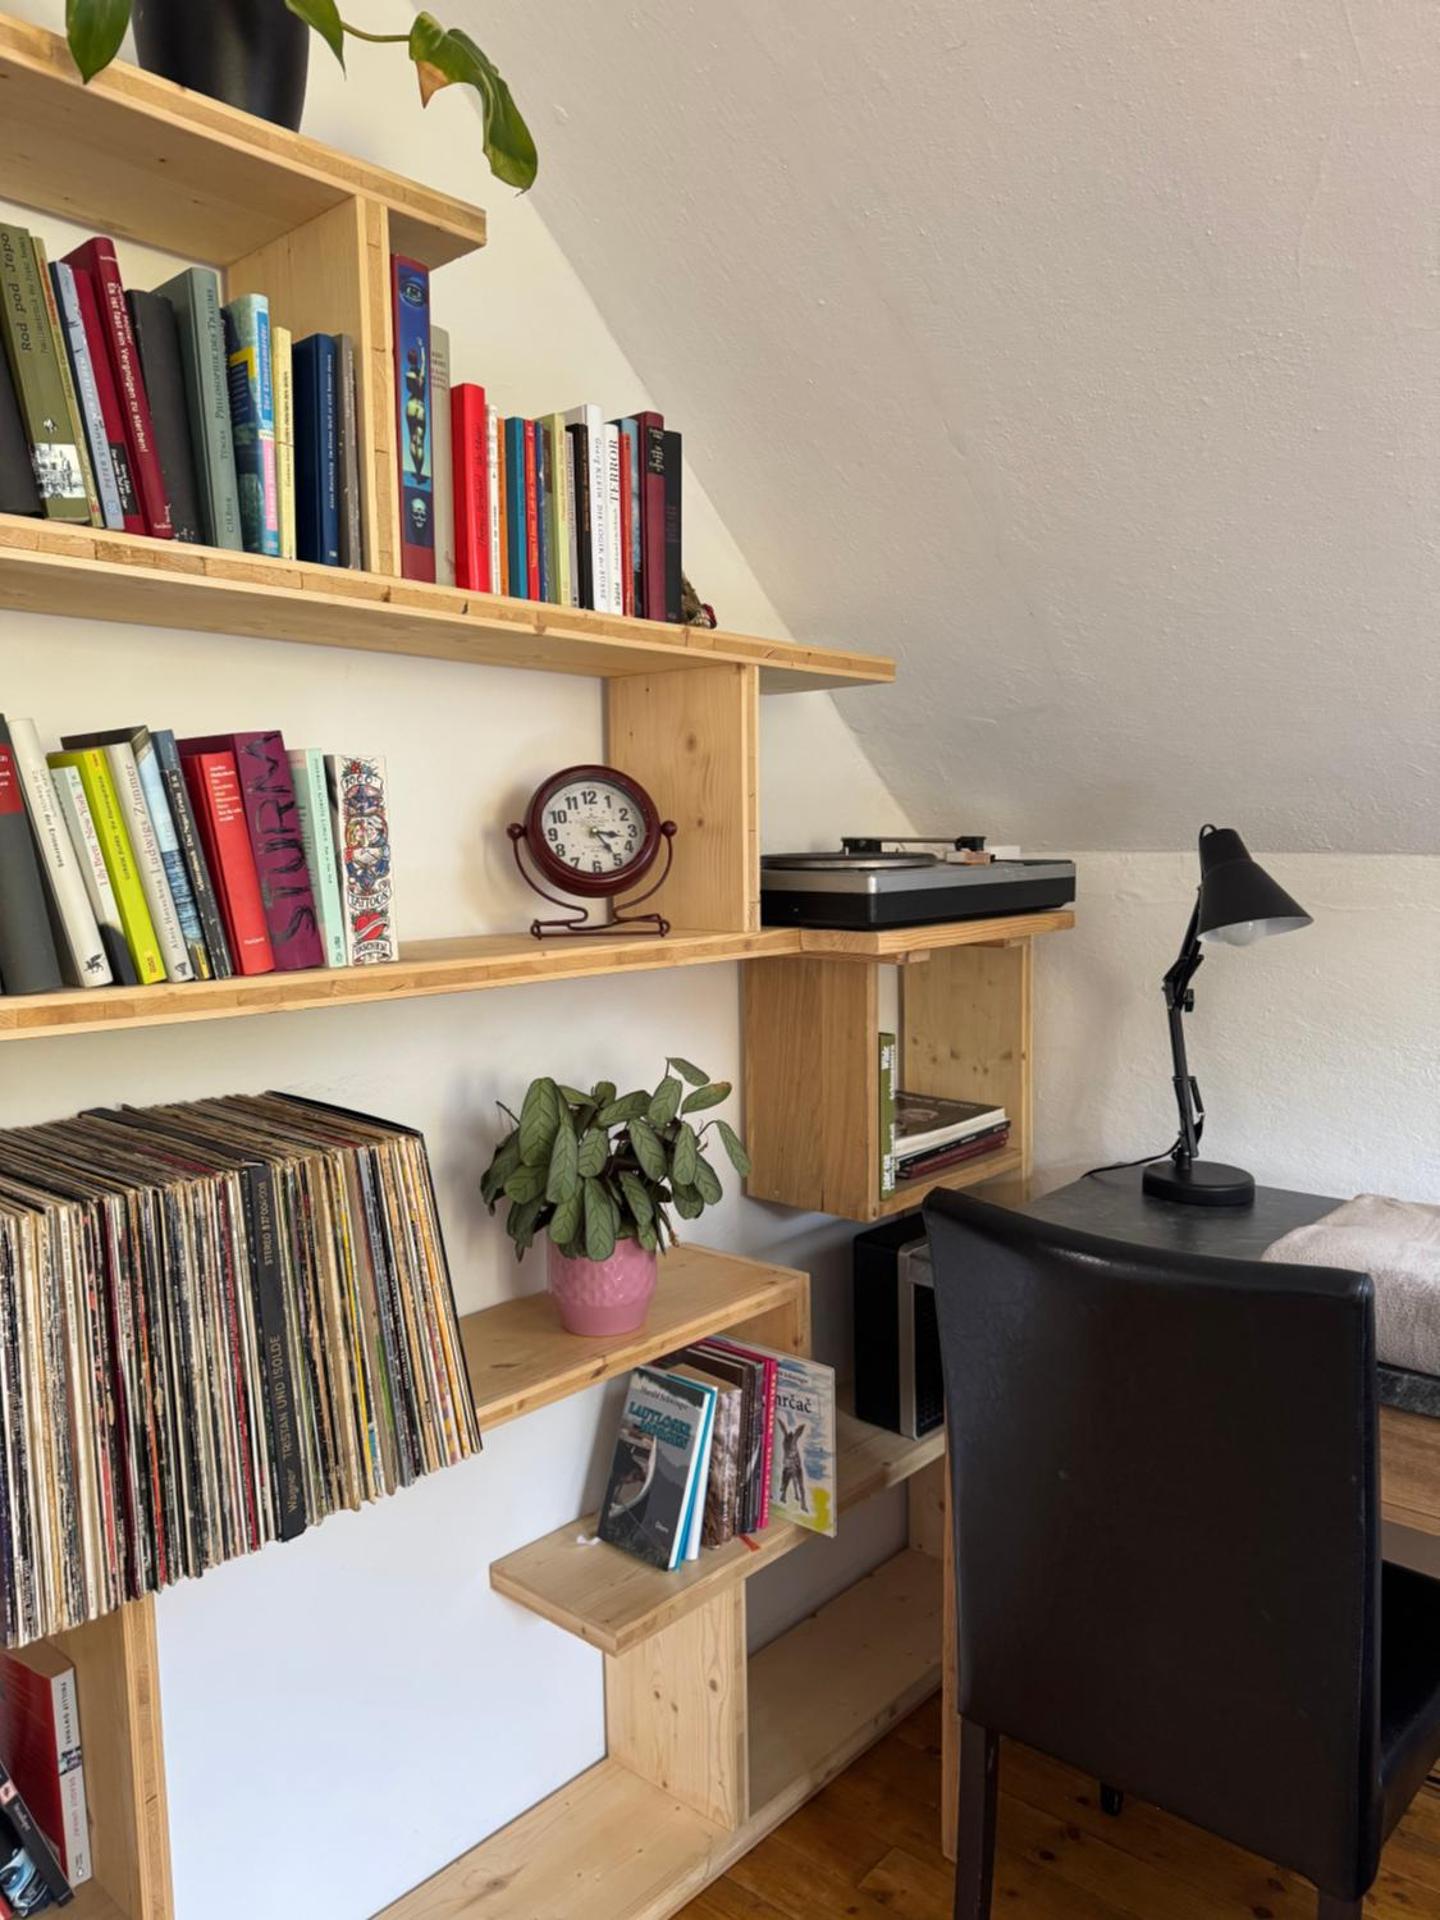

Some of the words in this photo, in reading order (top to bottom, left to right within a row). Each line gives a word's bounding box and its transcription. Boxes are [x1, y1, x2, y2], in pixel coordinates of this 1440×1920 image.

[106, 281, 117, 295] Es
[8, 282, 24, 313] pod
[109, 295, 119, 309] ist
[111, 310, 124, 330] fast
[16, 320, 31, 351] Rod
[115, 330, 126, 346] ein
[117, 347, 137, 399] Vergnügen
[129, 400, 138, 412] zu
[132, 413, 148, 454] sterben!
[608, 438, 618, 502] TERROR
[121, 762, 146, 816] Zimmer
[565, 796, 579, 810] 11
[581, 790, 597, 805] 12
[604, 795, 612, 809] 1
[551, 810, 567, 825] 10
[619, 808, 629, 822] 2
[548, 828, 558, 842] 9
[628, 824, 637, 838] 3
[137, 818, 162, 874] Ludwigs
[556, 844, 566, 857] 8
[625, 840, 634, 853] 4
[570, 857, 580, 870] 7
[592, 861, 602, 873] 6
[613, 853, 623, 867] 5
[350, 886, 389, 908] TATTOOS
[261, 1232, 273, 1265] STEREO
[268, 1335, 284, 1378] ISOLDE
[273, 1382, 287, 1408] UND
[276, 1411, 293, 1458] TRISTAN
[283, 1467, 300, 1512] Wagner
